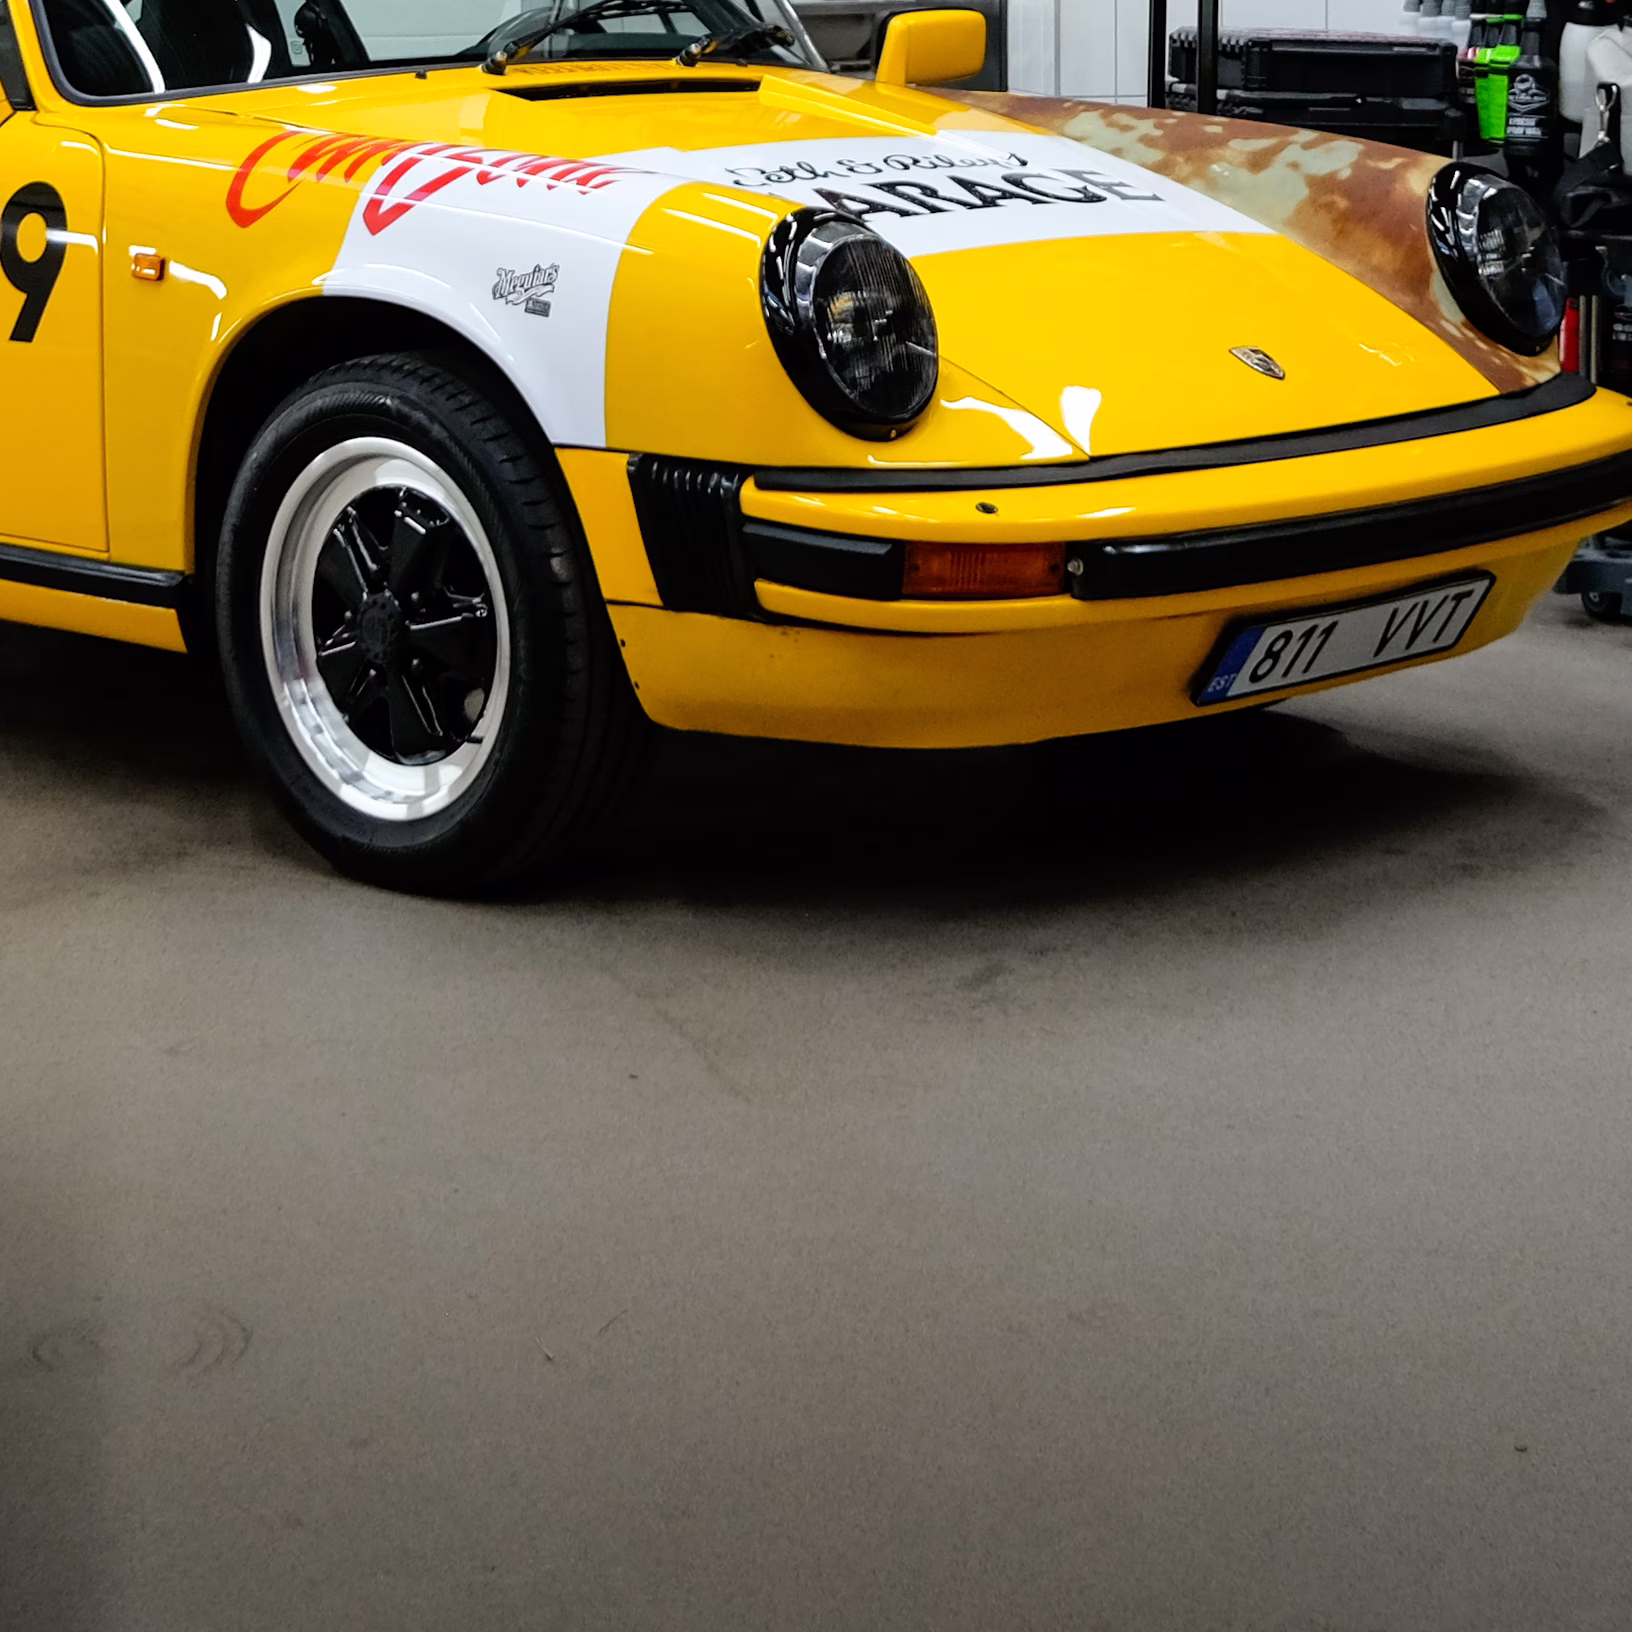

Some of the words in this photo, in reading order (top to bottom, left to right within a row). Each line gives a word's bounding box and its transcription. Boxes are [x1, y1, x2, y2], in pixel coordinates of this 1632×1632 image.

[772, 168, 1164, 223] ARAGE
[1249, 619, 1339, 684] 811
[1372, 588, 1476, 659] VVT
